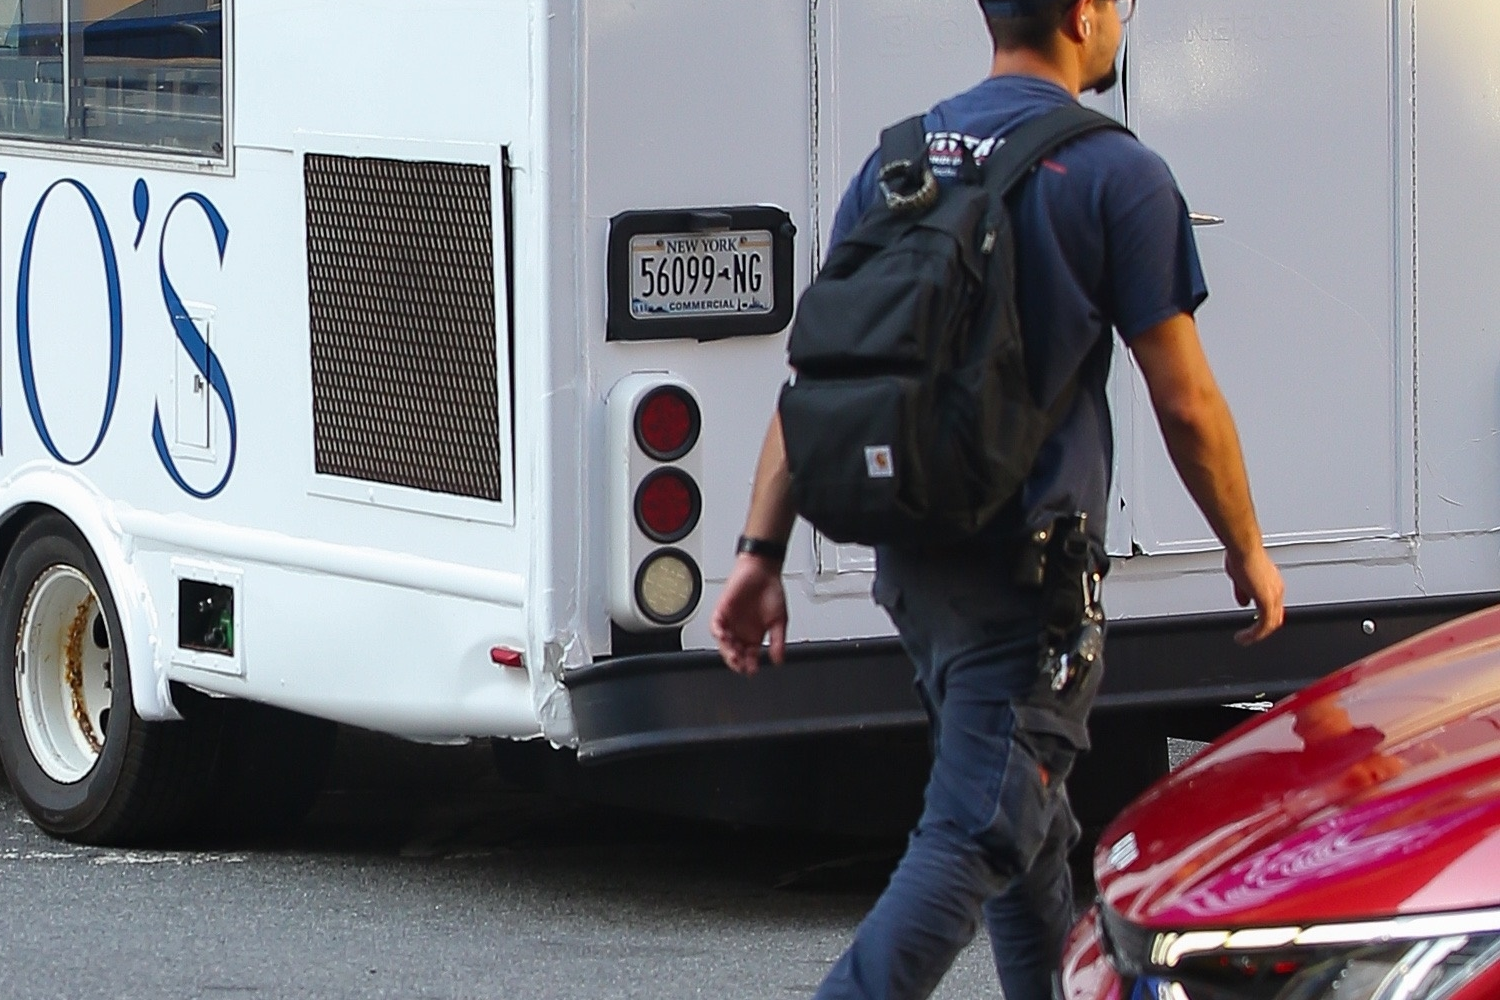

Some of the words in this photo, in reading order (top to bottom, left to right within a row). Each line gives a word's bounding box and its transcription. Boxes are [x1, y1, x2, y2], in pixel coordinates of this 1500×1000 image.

[666, 241, 698, 253] NEW
[700, 238, 738, 252] YORK
[668, 299, 735, 311] COMMERCIAL
